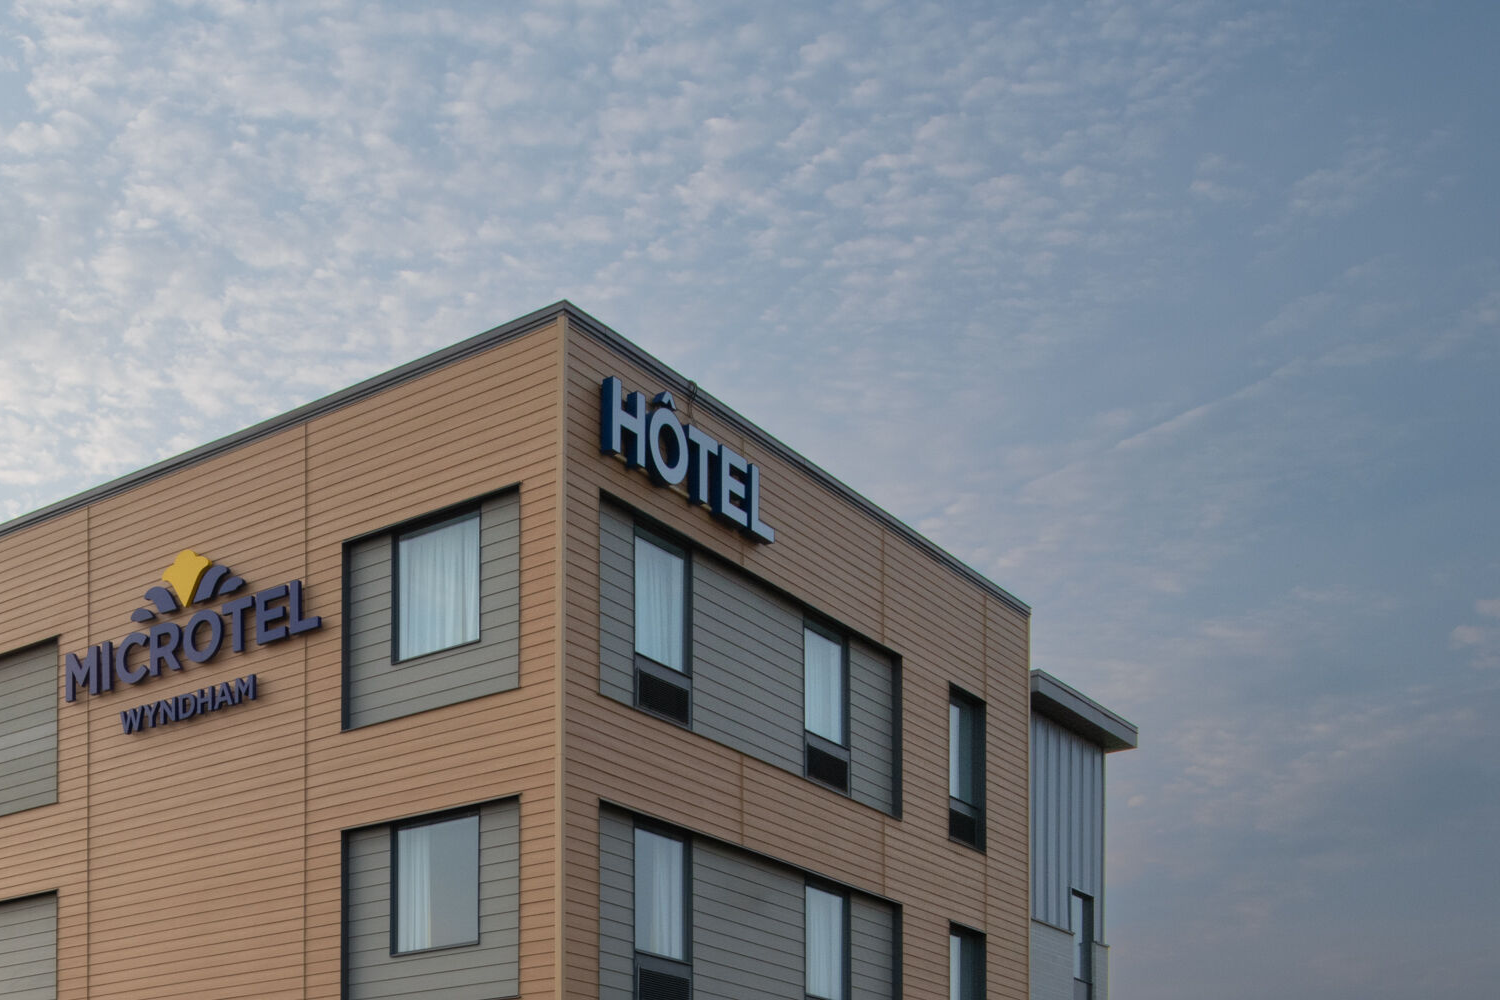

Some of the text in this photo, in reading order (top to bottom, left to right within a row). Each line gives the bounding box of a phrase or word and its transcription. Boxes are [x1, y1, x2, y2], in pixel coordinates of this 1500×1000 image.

[602, 375, 775, 544] HÔTEL
[65, 579, 322, 703] MICROTEL
[120, 674, 257, 734] WYNDHAM
